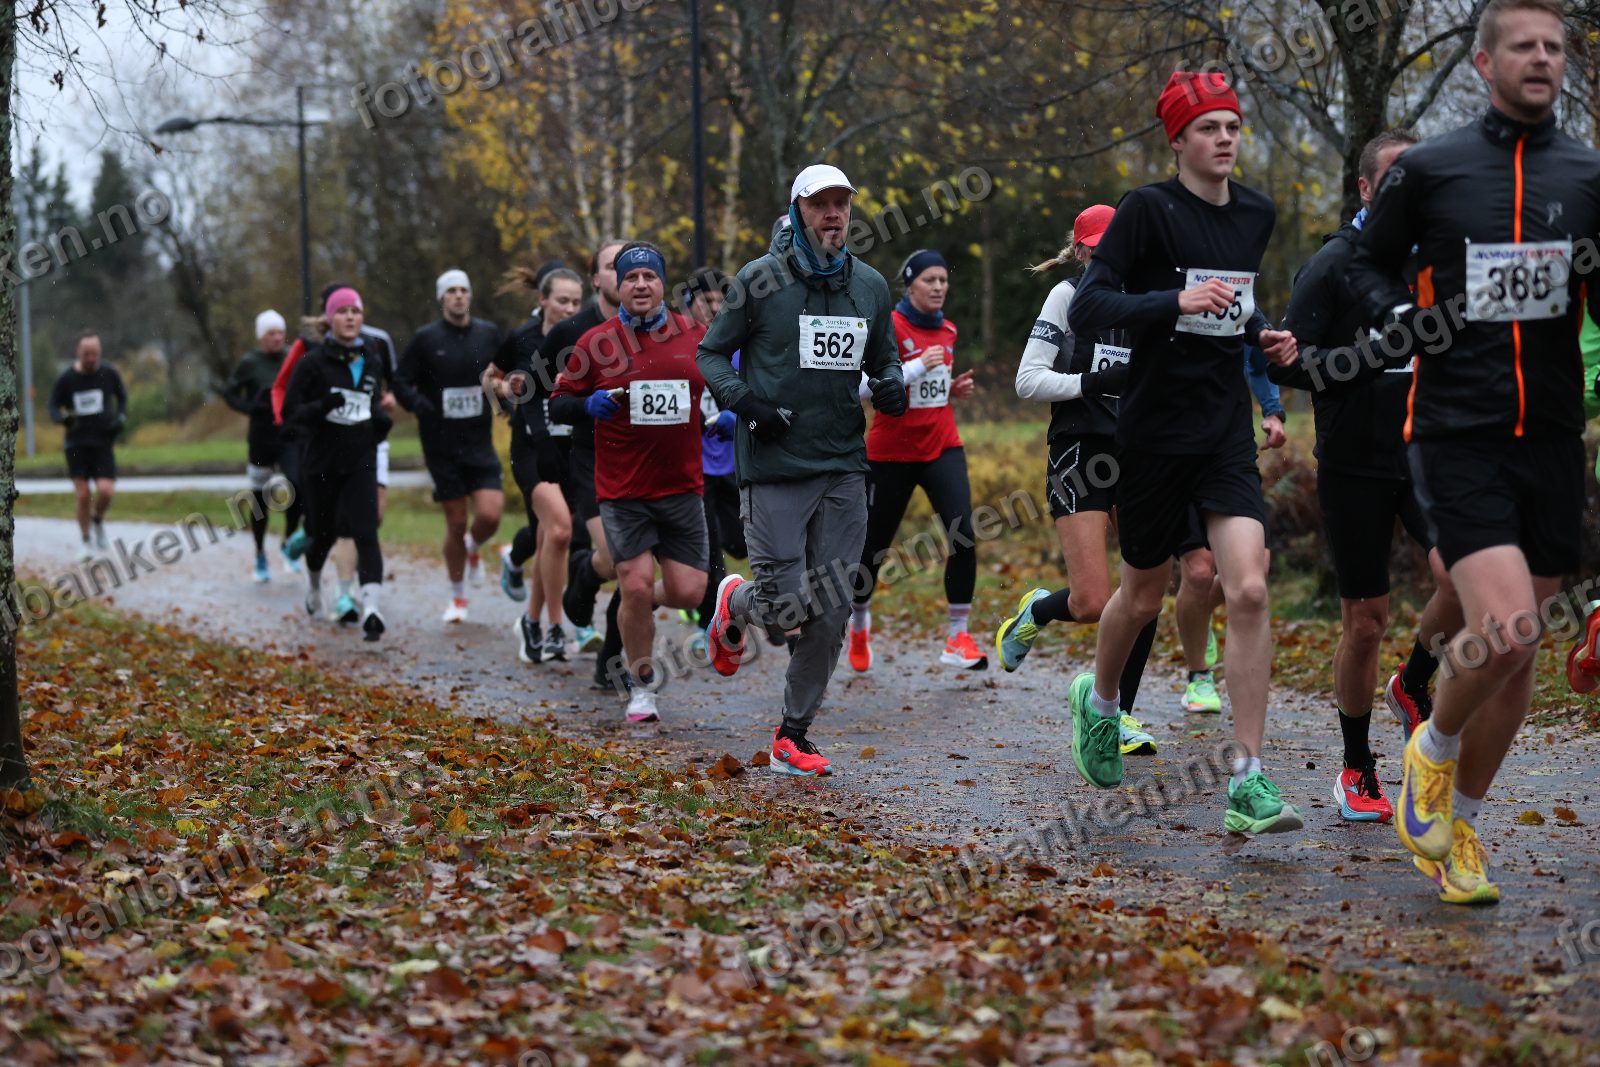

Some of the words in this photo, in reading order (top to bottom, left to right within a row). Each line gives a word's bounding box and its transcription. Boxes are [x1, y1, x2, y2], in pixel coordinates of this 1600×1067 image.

[813, 331, 855, 359] 562
[919, 378, 946, 399] 664
[642, 393, 679, 415] 824
